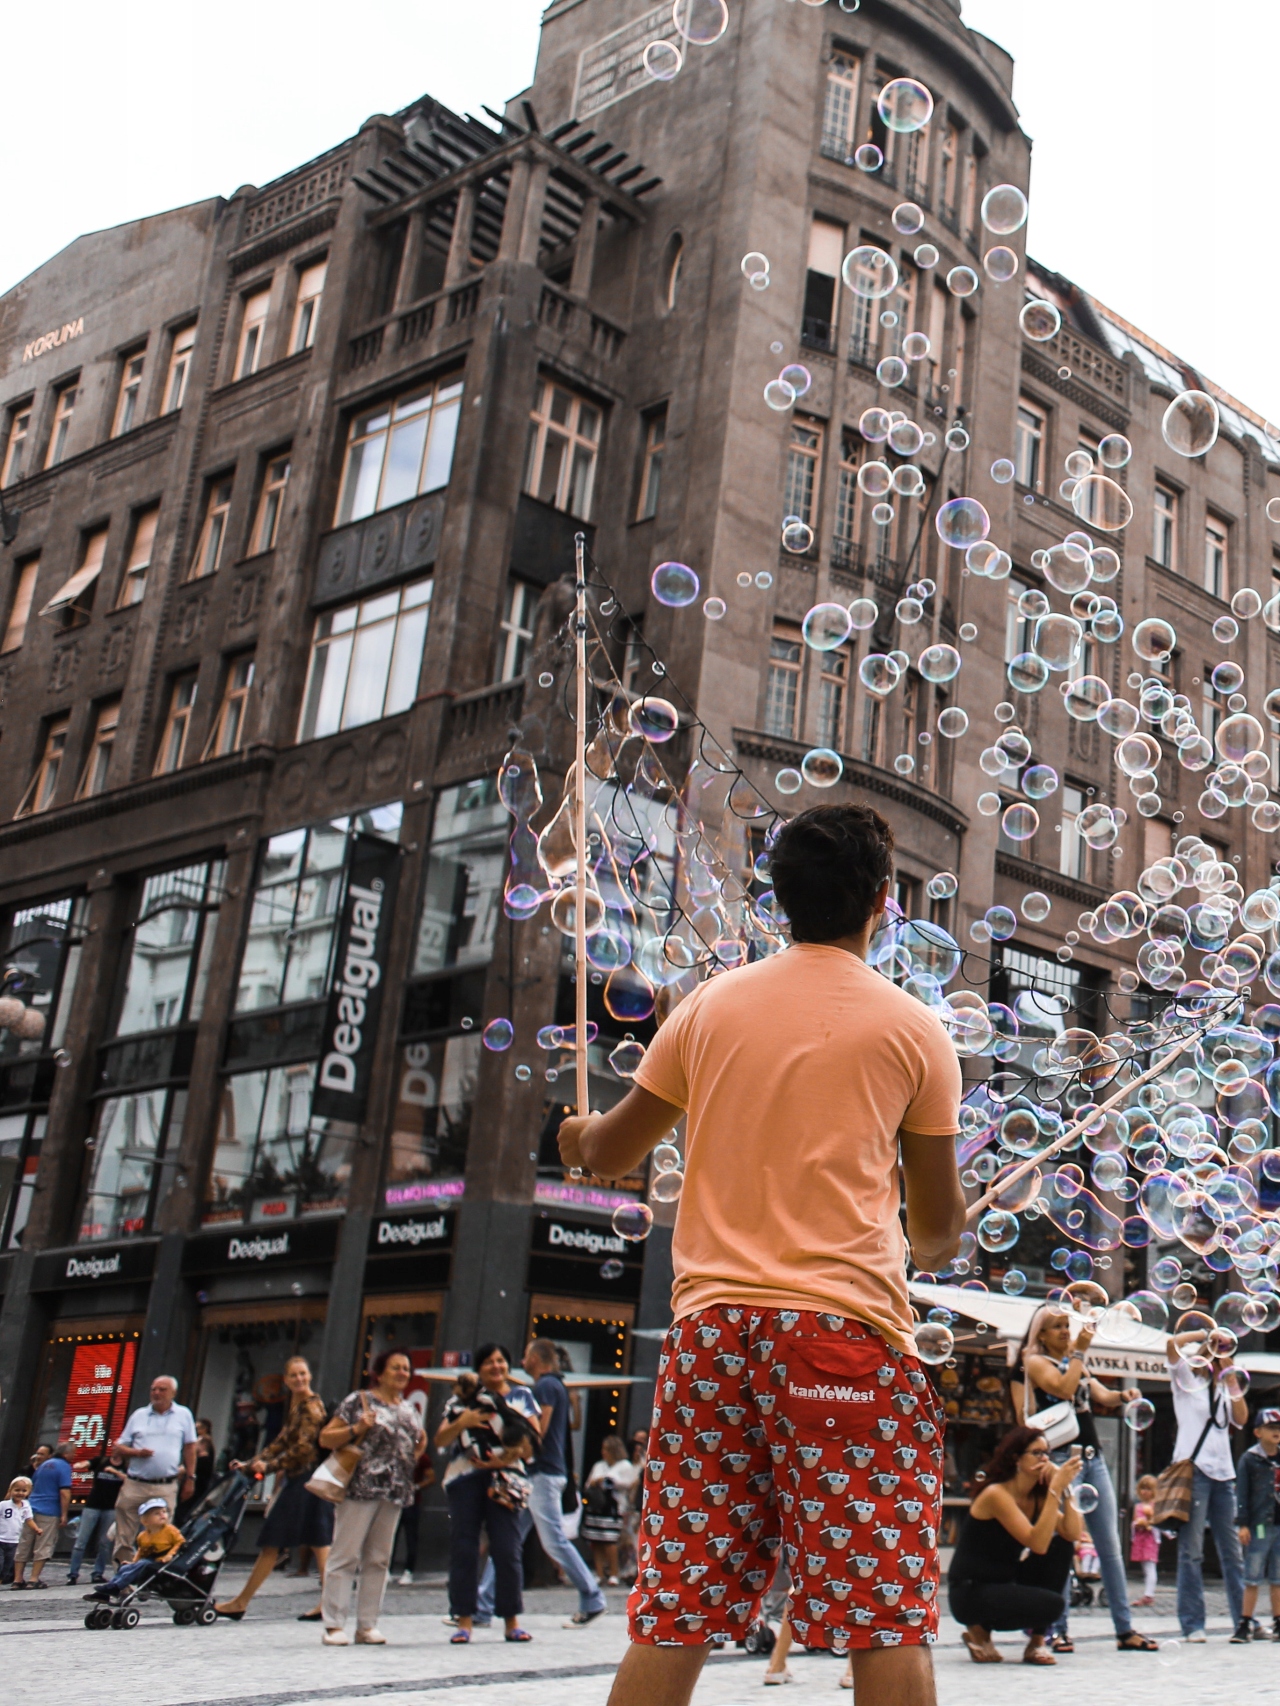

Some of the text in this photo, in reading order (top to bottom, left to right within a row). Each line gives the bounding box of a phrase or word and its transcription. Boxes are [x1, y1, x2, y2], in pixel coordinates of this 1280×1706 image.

[22, 316, 84, 362] KORUNA
[320, 884, 383, 1093] Desigual
[378, 1215, 445, 1245] Desigual
[548, 1223, 625, 1253] Desigual
[228, 1231, 289, 1261] Desigual
[66, 1252, 120, 1279] Desigual
[1084, 1356, 1168, 1374] AVSKÁ KLOB
[790, 1381, 876, 1401] kanYeWest
[4, 1507, 13, 1519] 9
